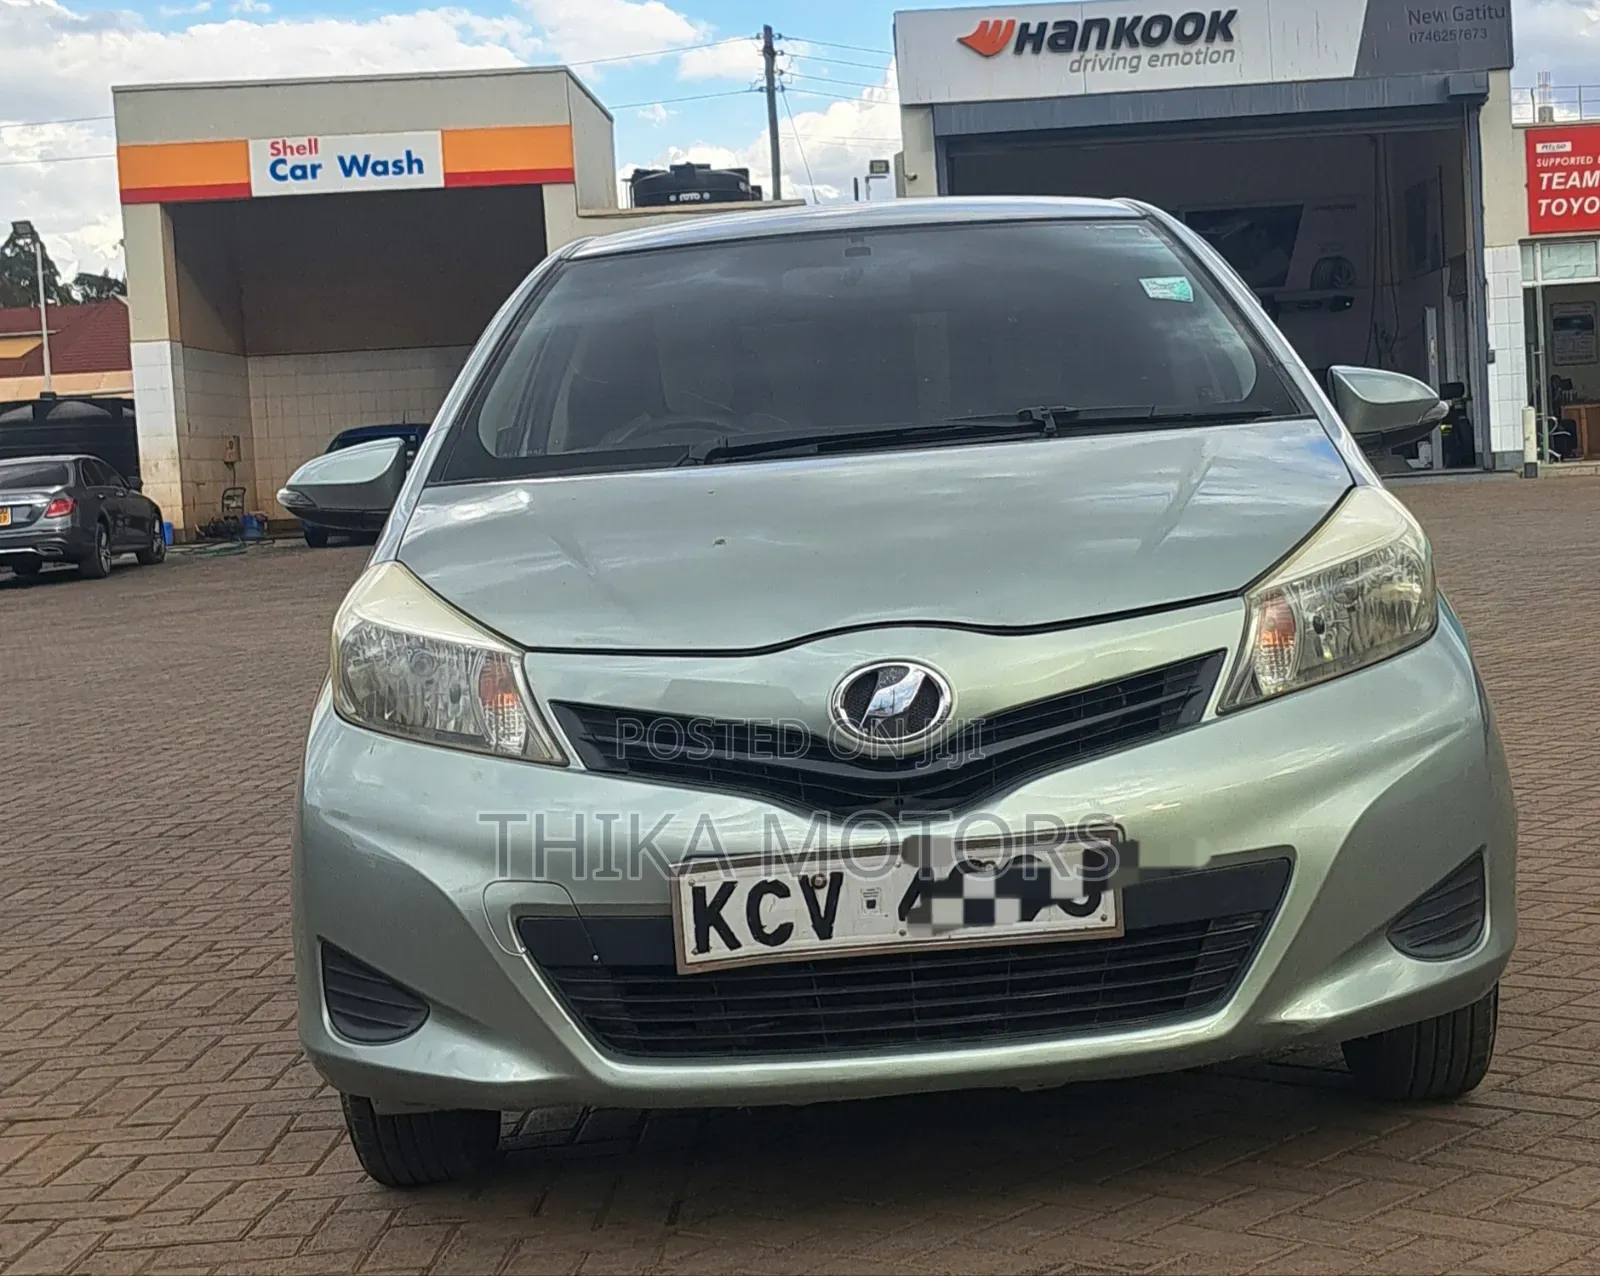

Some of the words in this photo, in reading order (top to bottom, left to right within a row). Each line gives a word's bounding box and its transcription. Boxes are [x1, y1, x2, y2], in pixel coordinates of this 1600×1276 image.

[1408, 9, 1447, 25] New
[1452, 4, 1505, 22] Gatitu
[1069, 51, 1142, 74] driving
[1147, 47, 1235, 69] emotion
[269, 137, 318, 157] Shell
[269, 158, 322, 182] Car
[337, 150, 424, 178] Wash
[1536, 156, 1593, 168] SUPPORTED
[1539, 170, 1600, 190] TEAM
[1538, 196, 1600, 217] TOYO
[690, 871, 844, 954] KCV
